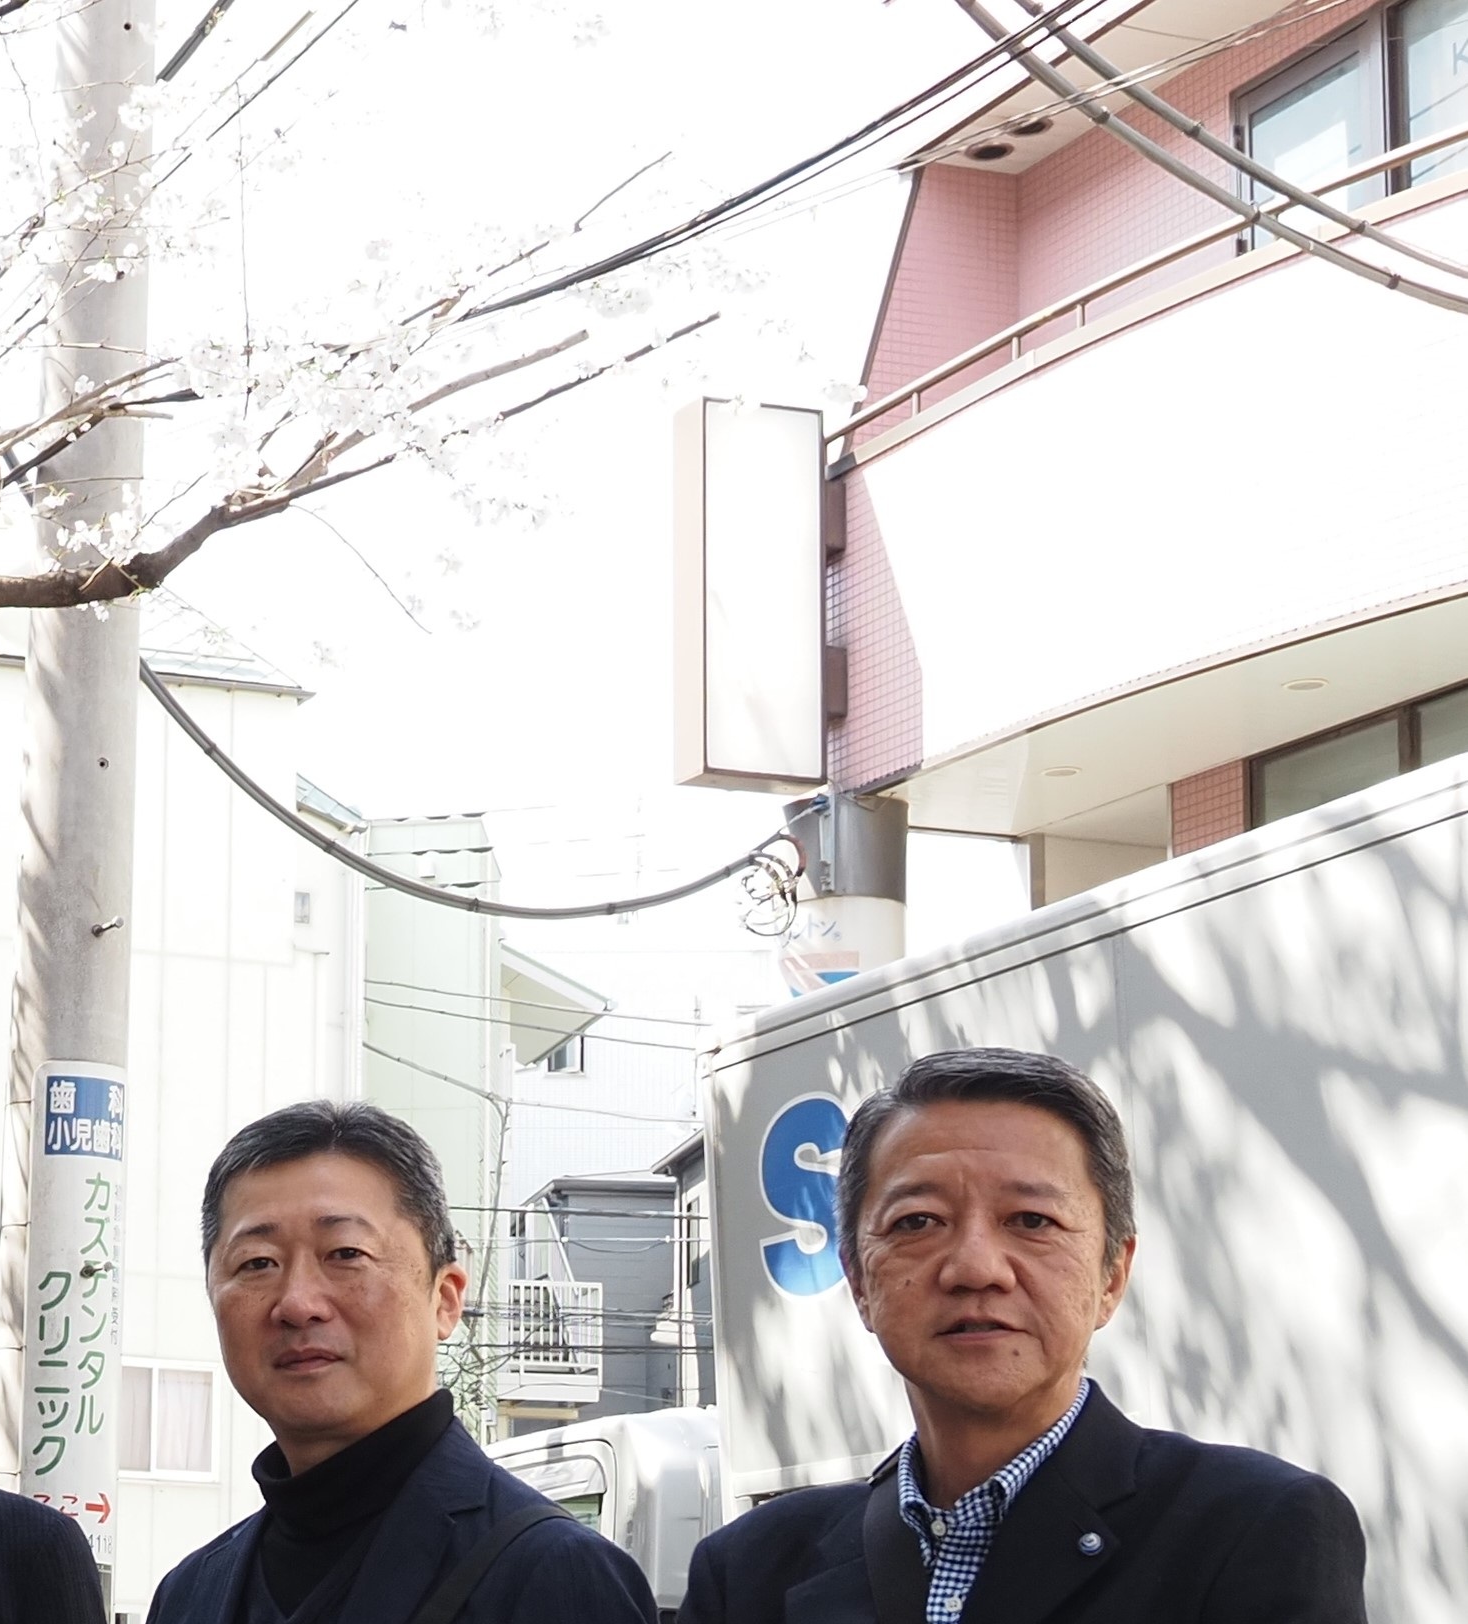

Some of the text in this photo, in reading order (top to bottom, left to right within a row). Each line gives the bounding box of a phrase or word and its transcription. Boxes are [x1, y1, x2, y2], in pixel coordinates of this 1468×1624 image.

[47, 1116, 124, 1159] 小児歯科
[32, 1270, 72, 1477] クリニック
